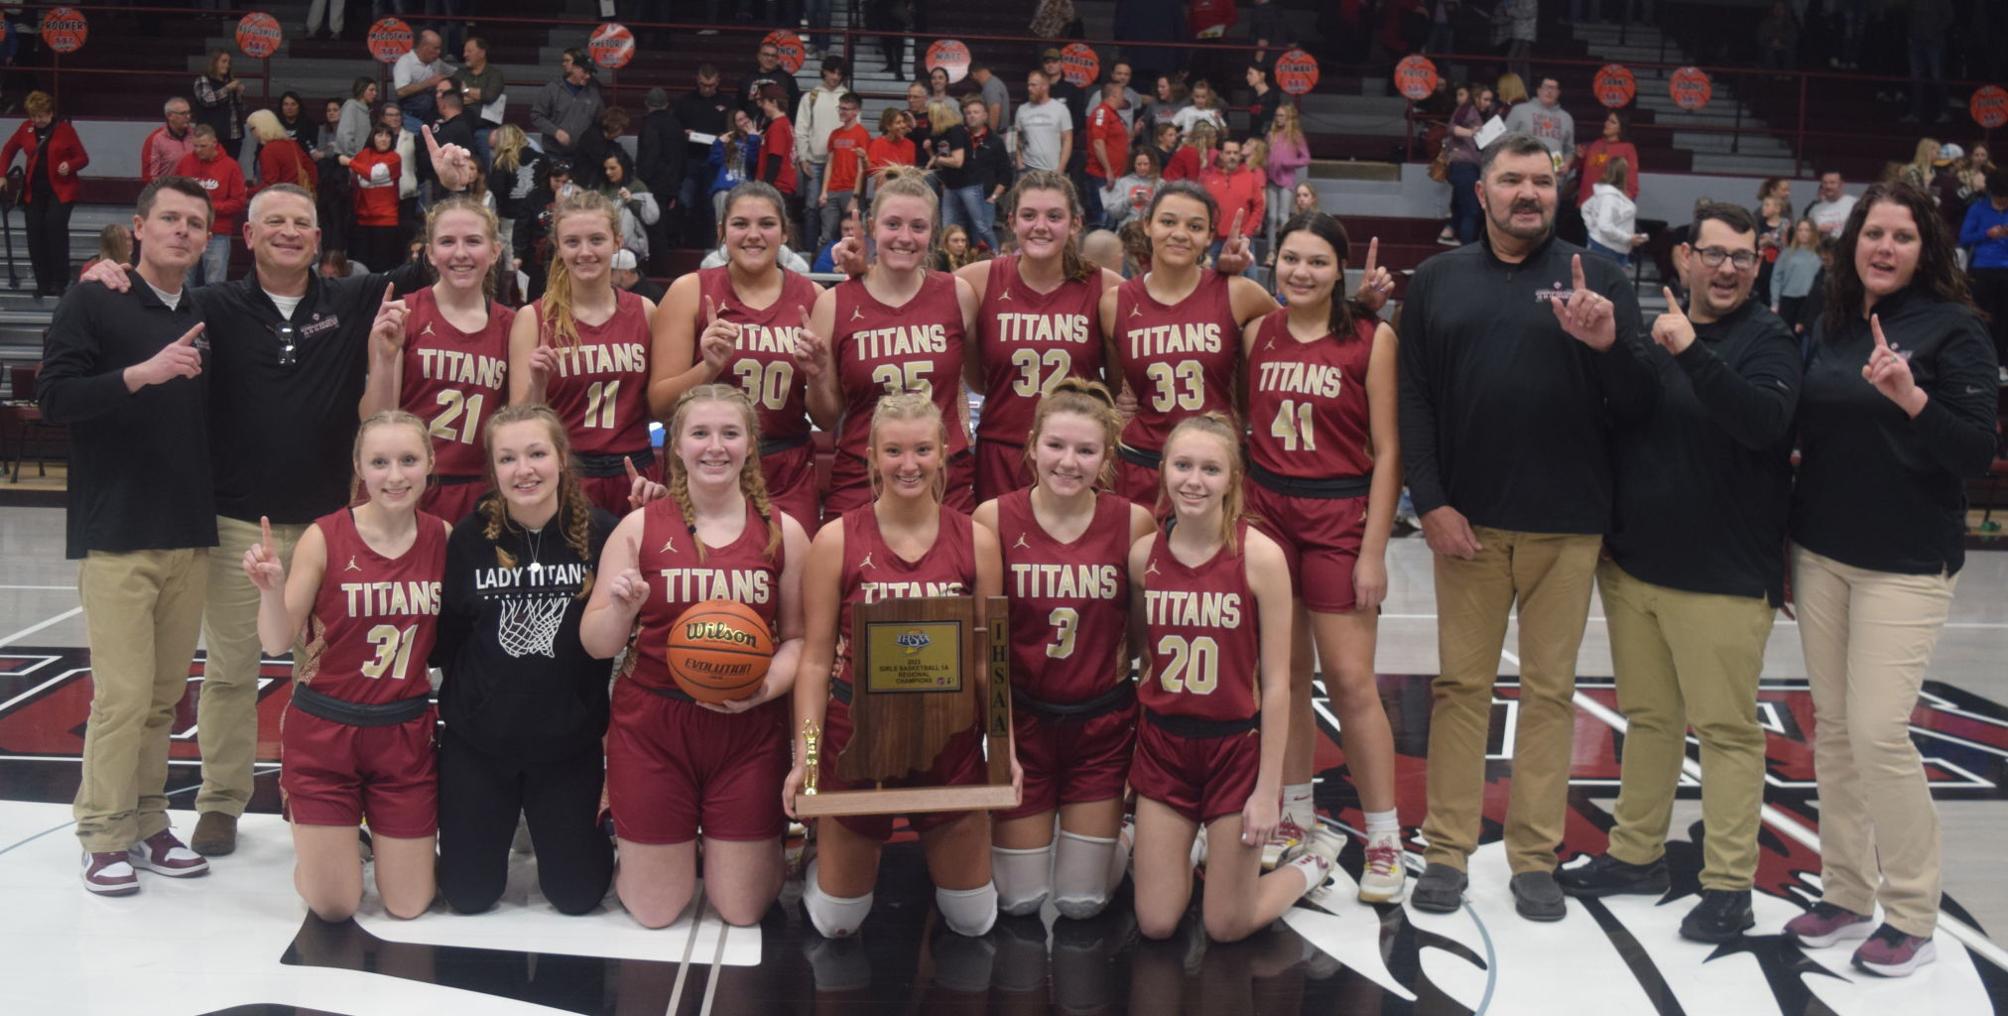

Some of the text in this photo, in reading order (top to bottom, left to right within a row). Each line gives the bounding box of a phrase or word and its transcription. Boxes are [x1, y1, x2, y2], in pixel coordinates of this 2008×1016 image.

[735, 323, 803, 354] ITANS
[852, 323, 948, 361] TITANS
[997, 311, 1090, 343] TITANS
[1127, 323, 1222, 360] TITANS
[416, 348, 507, 391] TITANS
[557, 343, 646, 378] TITANS
[872, 359, 935, 398] 35
[1011, 347, 1073, 398] 32
[1258, 360, 1342, 399] TITANS
[733, 358, 795, 411] 30
[1147, 360, 1205, 414] 33
[429, 388, 484, 445] 21
[584, 379, 621, 430] 11
[1271, 398, 1317, 452] 41
[475, 567, 524, 590] LADY
[660, 567, 771, 604] TITANS
[1010, 562, 1118, 600] TITANS
[340, 580, 443, 619] TITANS
[1143, 589, 1243, 629] TITANS
[359, 622, 420, 681] 31
[685, 621, 758, 649] Wilson
[1045, 606, 1079, 661] 3
[684, 657, 753, 676] EVOLUTION
[991, 624, 1006, 732] IHSAA
[1157, 634, 1219, 695] 20
